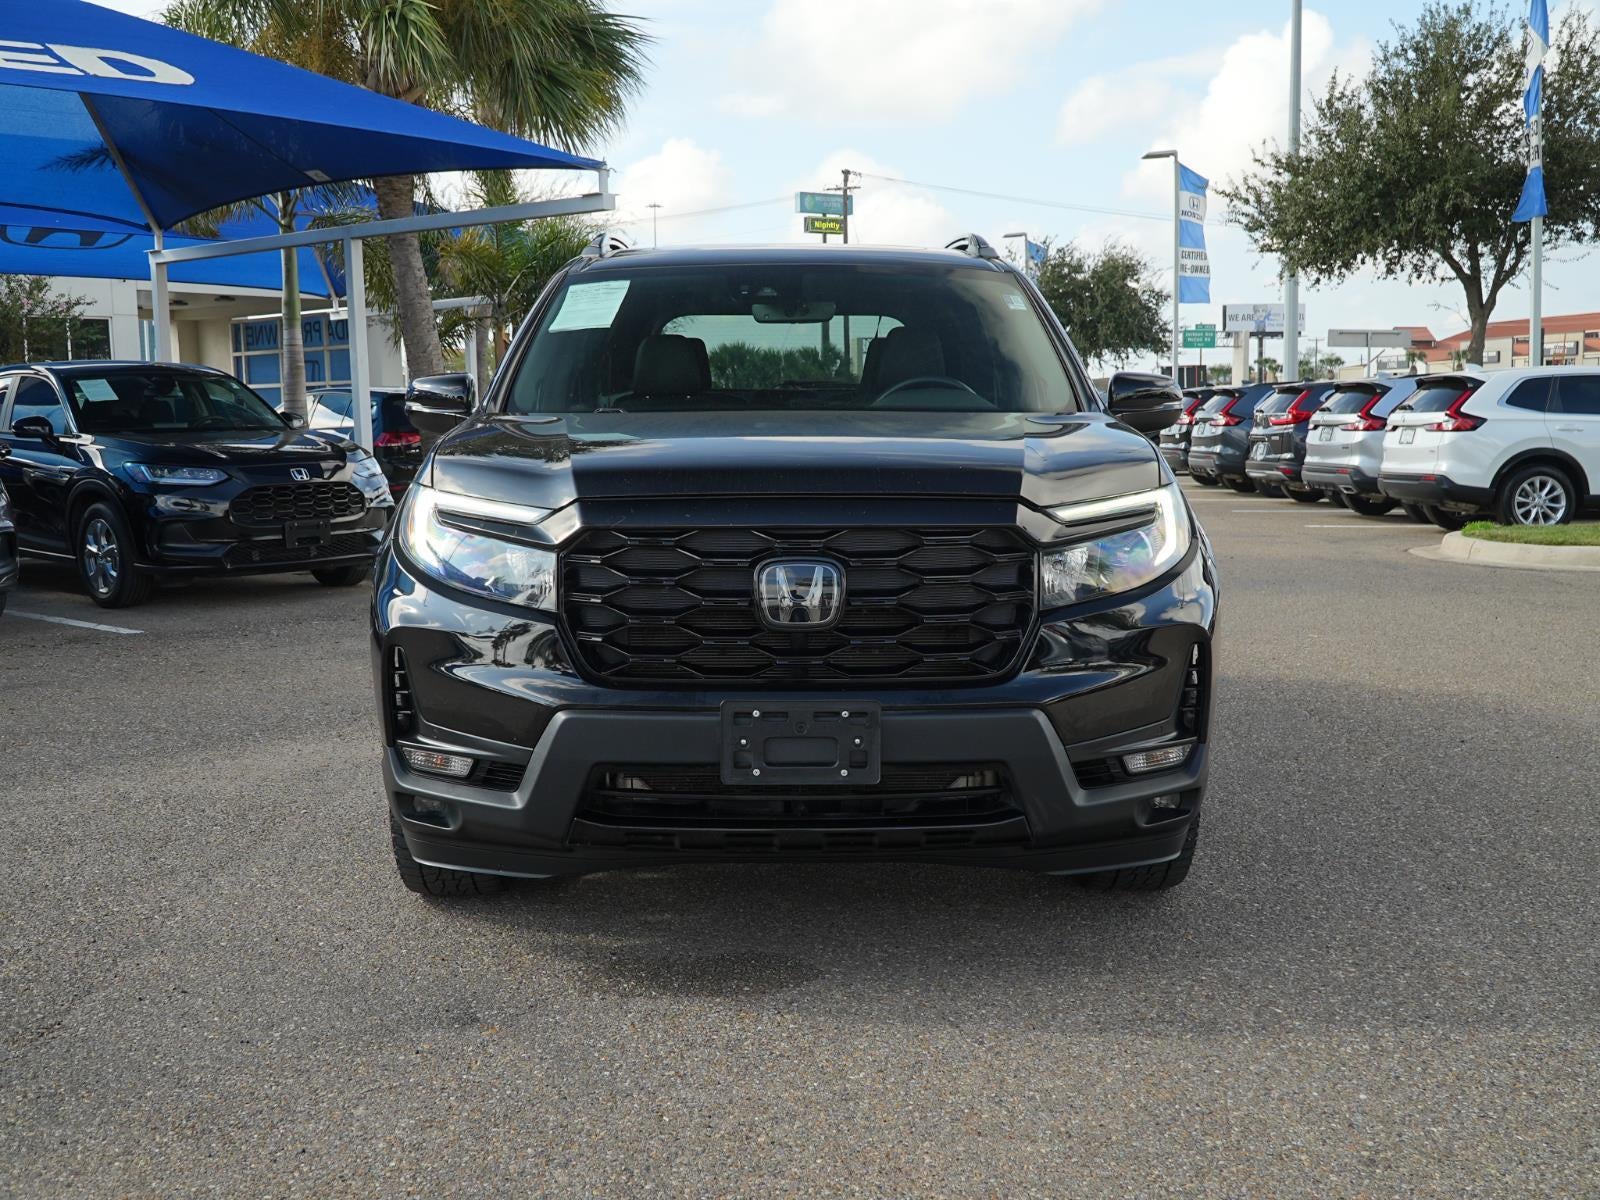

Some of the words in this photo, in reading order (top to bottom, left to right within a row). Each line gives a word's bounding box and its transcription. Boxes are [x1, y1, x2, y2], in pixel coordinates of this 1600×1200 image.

[814, 221, 840, 231] Nightly
[1181, 250, 1208, 261] CERTIFIED
[1228, 313, 1240, 321] WE
[1241, 313, 1255, 321] ARE
